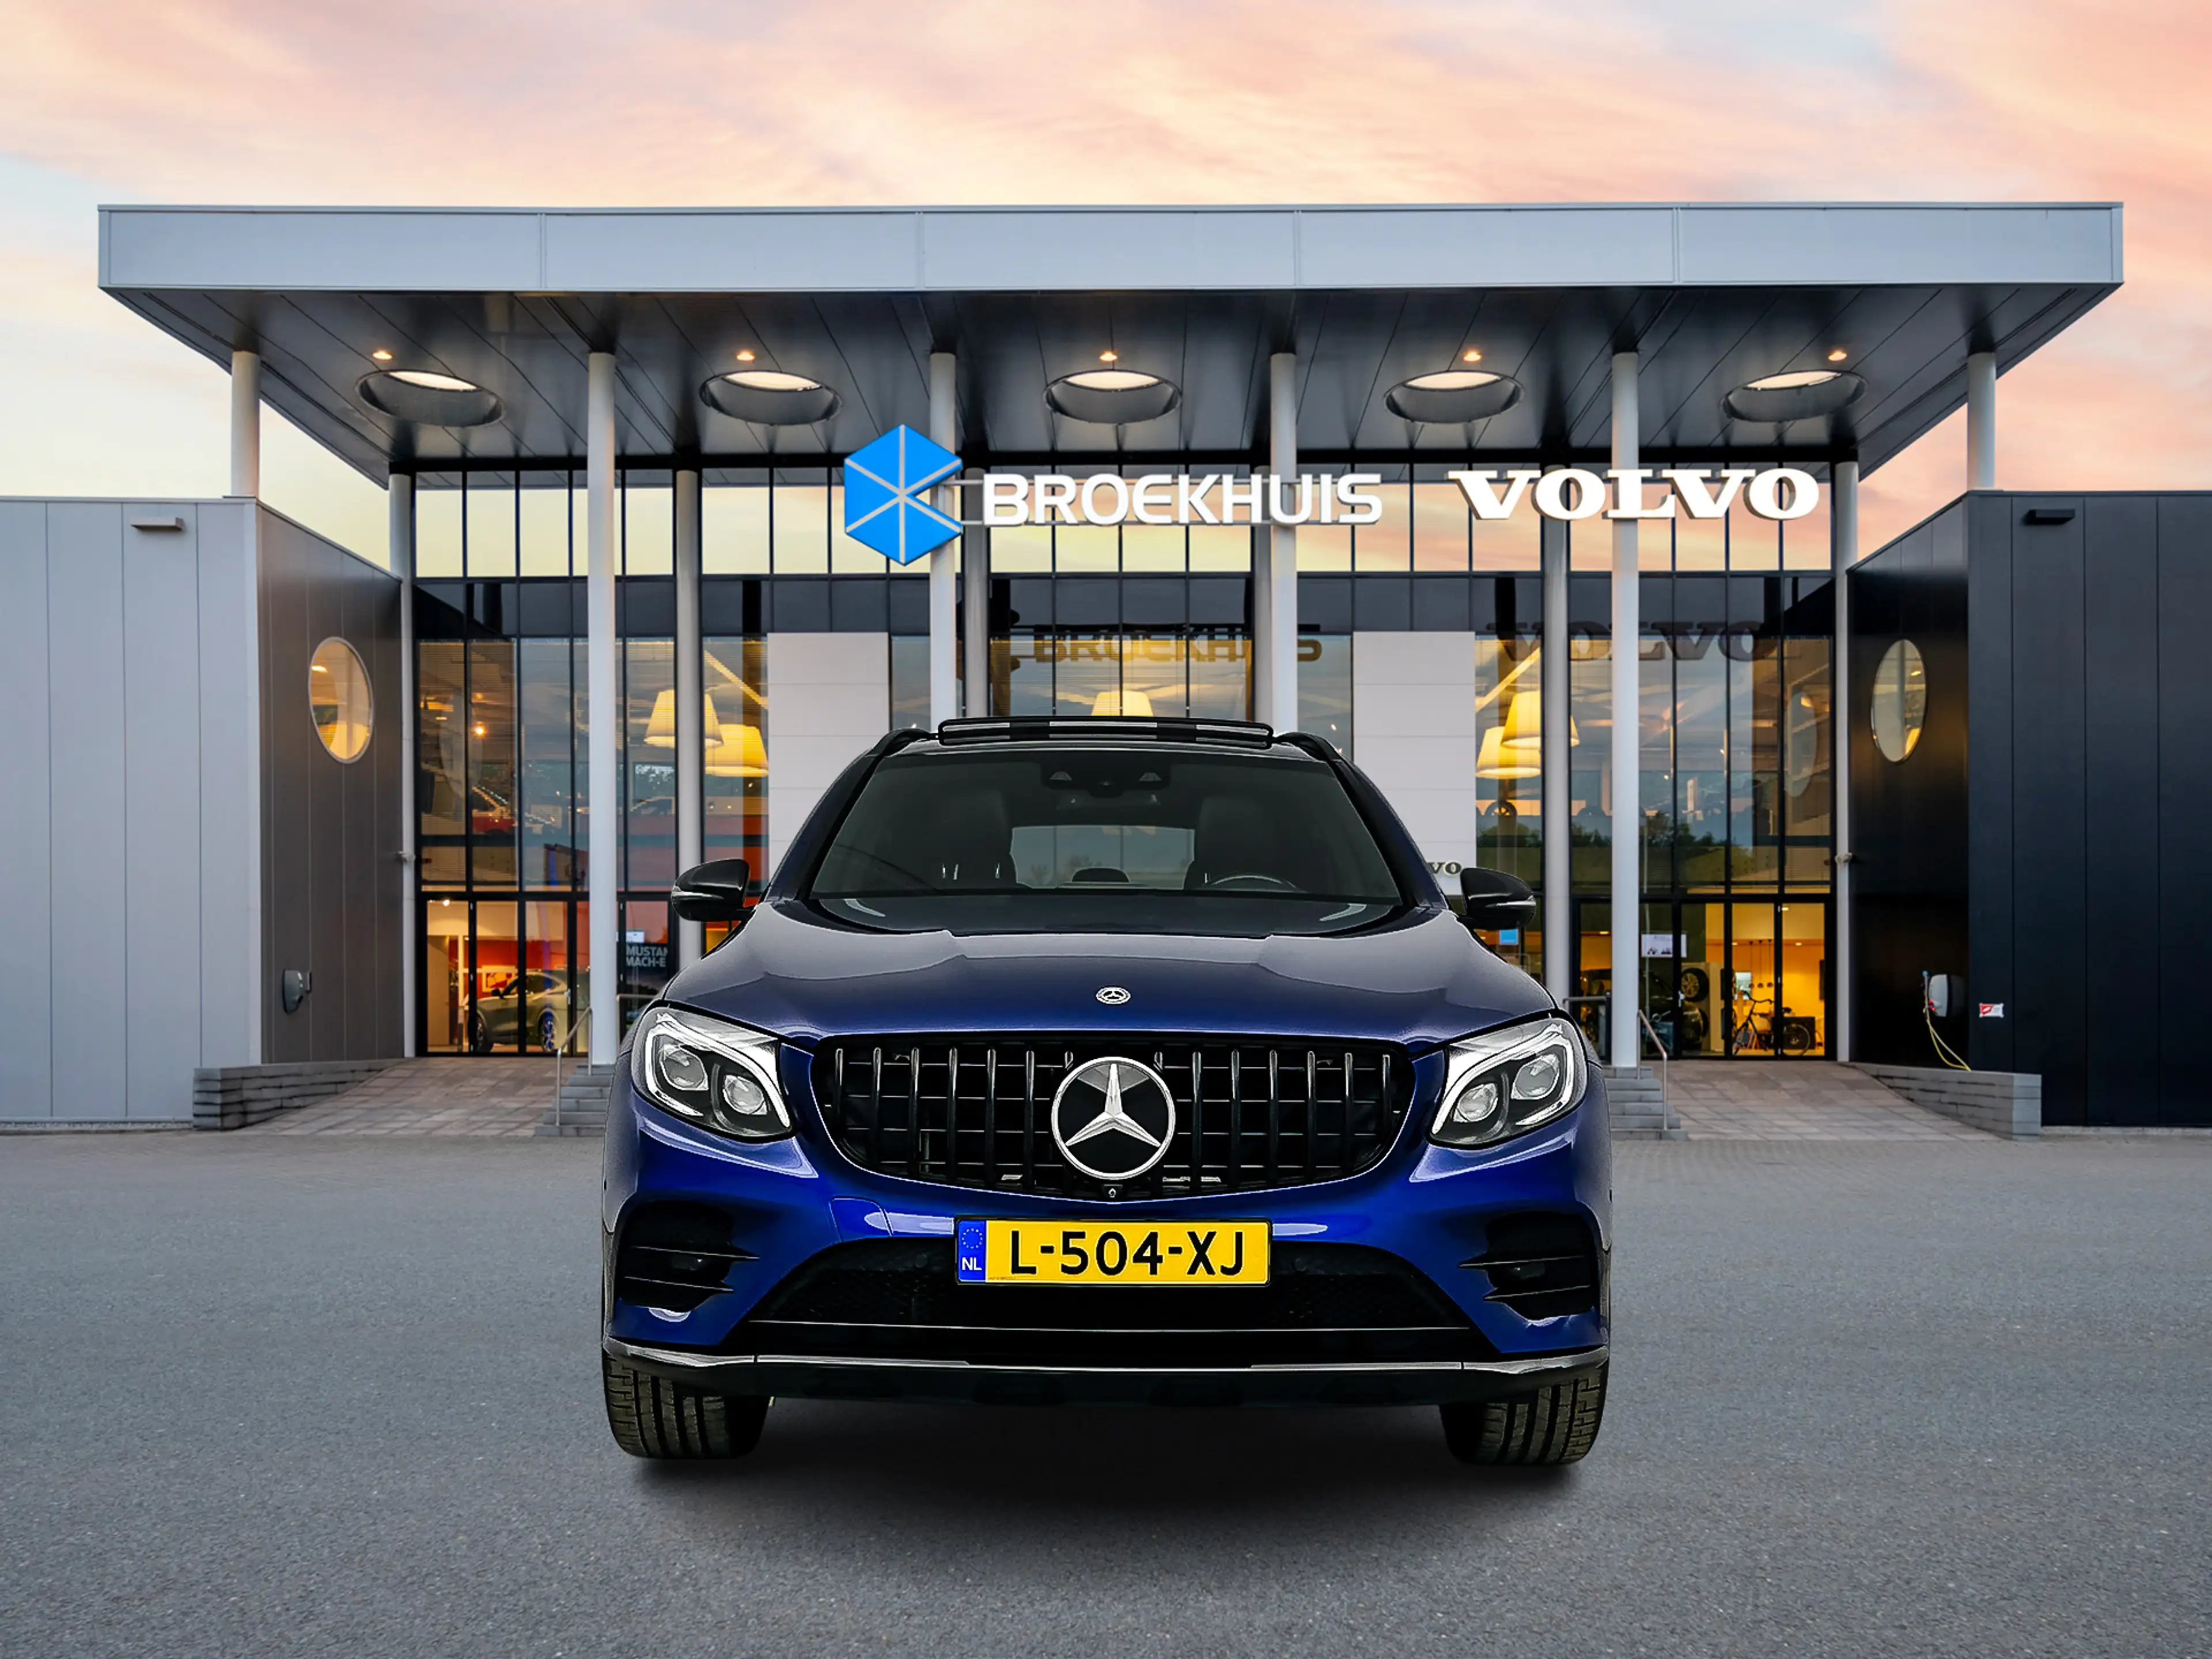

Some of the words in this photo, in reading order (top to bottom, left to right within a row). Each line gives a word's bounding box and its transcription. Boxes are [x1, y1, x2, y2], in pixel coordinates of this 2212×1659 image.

[983, 474, 1383, 525] BROEKHUIS
[1446, 468, 1820, 520] VOLVO
[961, 1257, 982, 1271] NL
[1010, 1230, 1243, 1276] L-504-XJ
